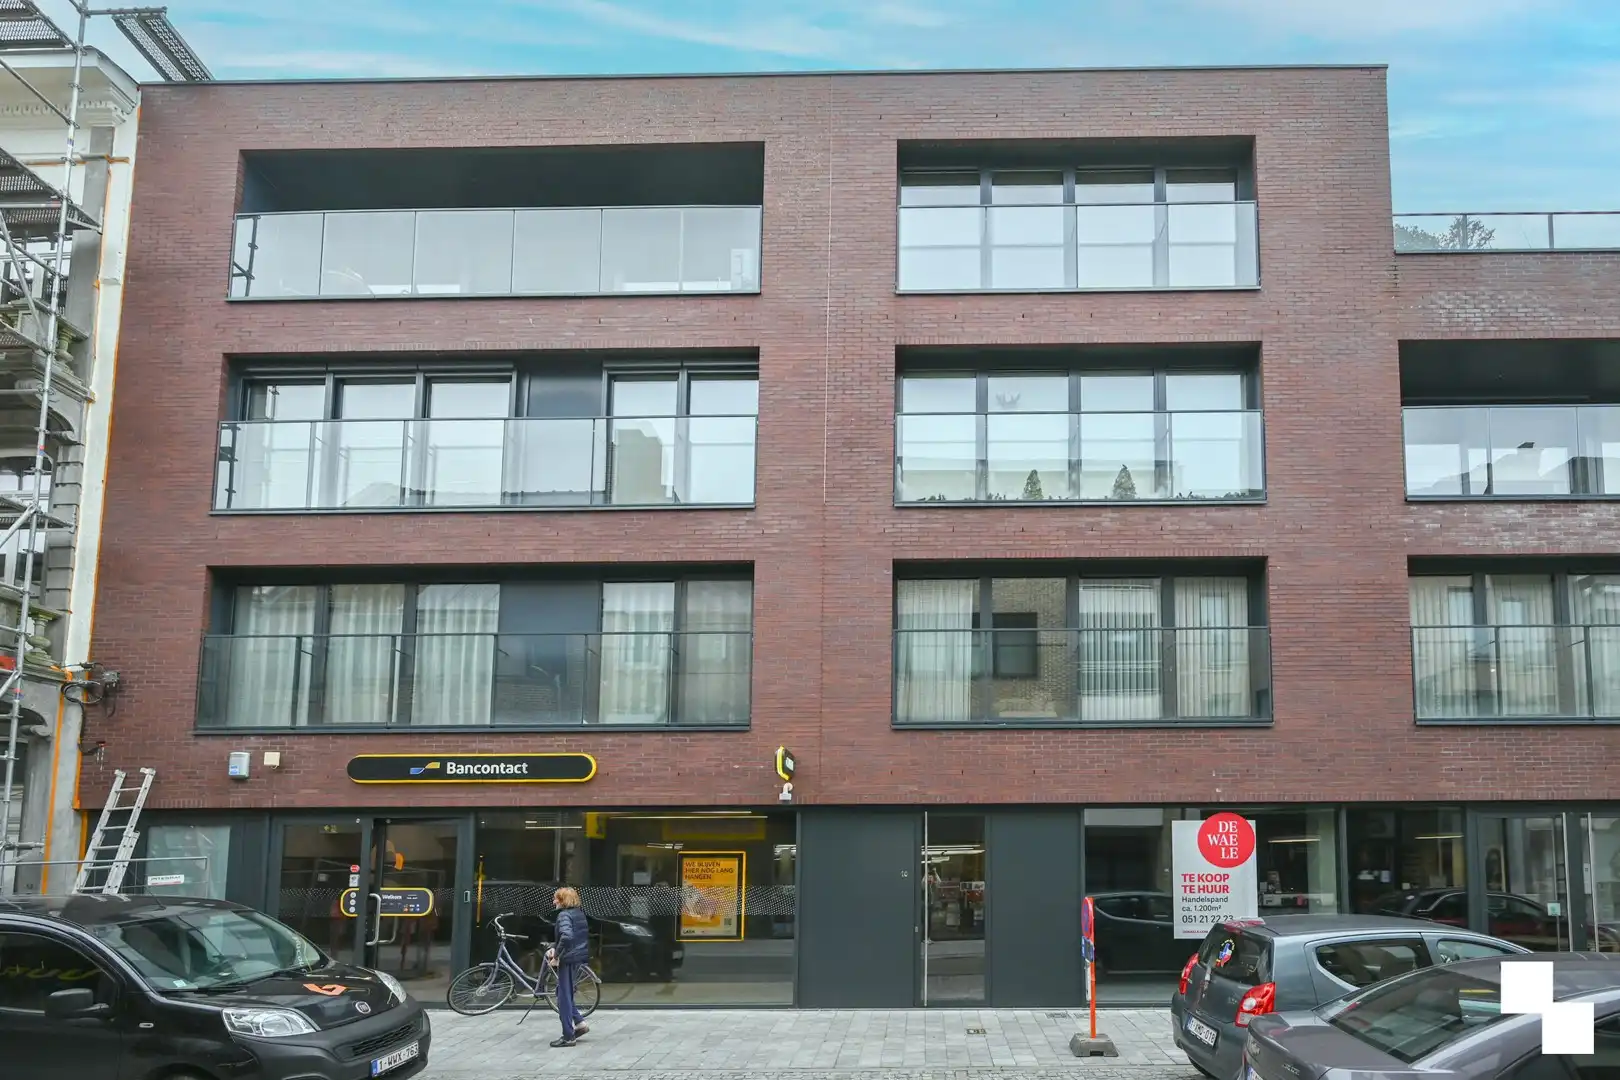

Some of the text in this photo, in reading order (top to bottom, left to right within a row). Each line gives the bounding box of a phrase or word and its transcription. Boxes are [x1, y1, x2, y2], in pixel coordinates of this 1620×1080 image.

[446, 761, 528, 775] Bancontact
[1218, 821, 1238, 833] DE
[1207, 834, 1238, 847] WAE
[1220, 847, 1239, 859] LE
[1181, 873, 1230, 883] TE KOOP
[1181, 885, 1230, 894] TE HUUR
[1181, 896, 1229, 904] Handelspand
[1182, 915, 1197, 923] 051
[1199, 915, 1208, 923] 21
[1210, 915, 1221, 923] 22
